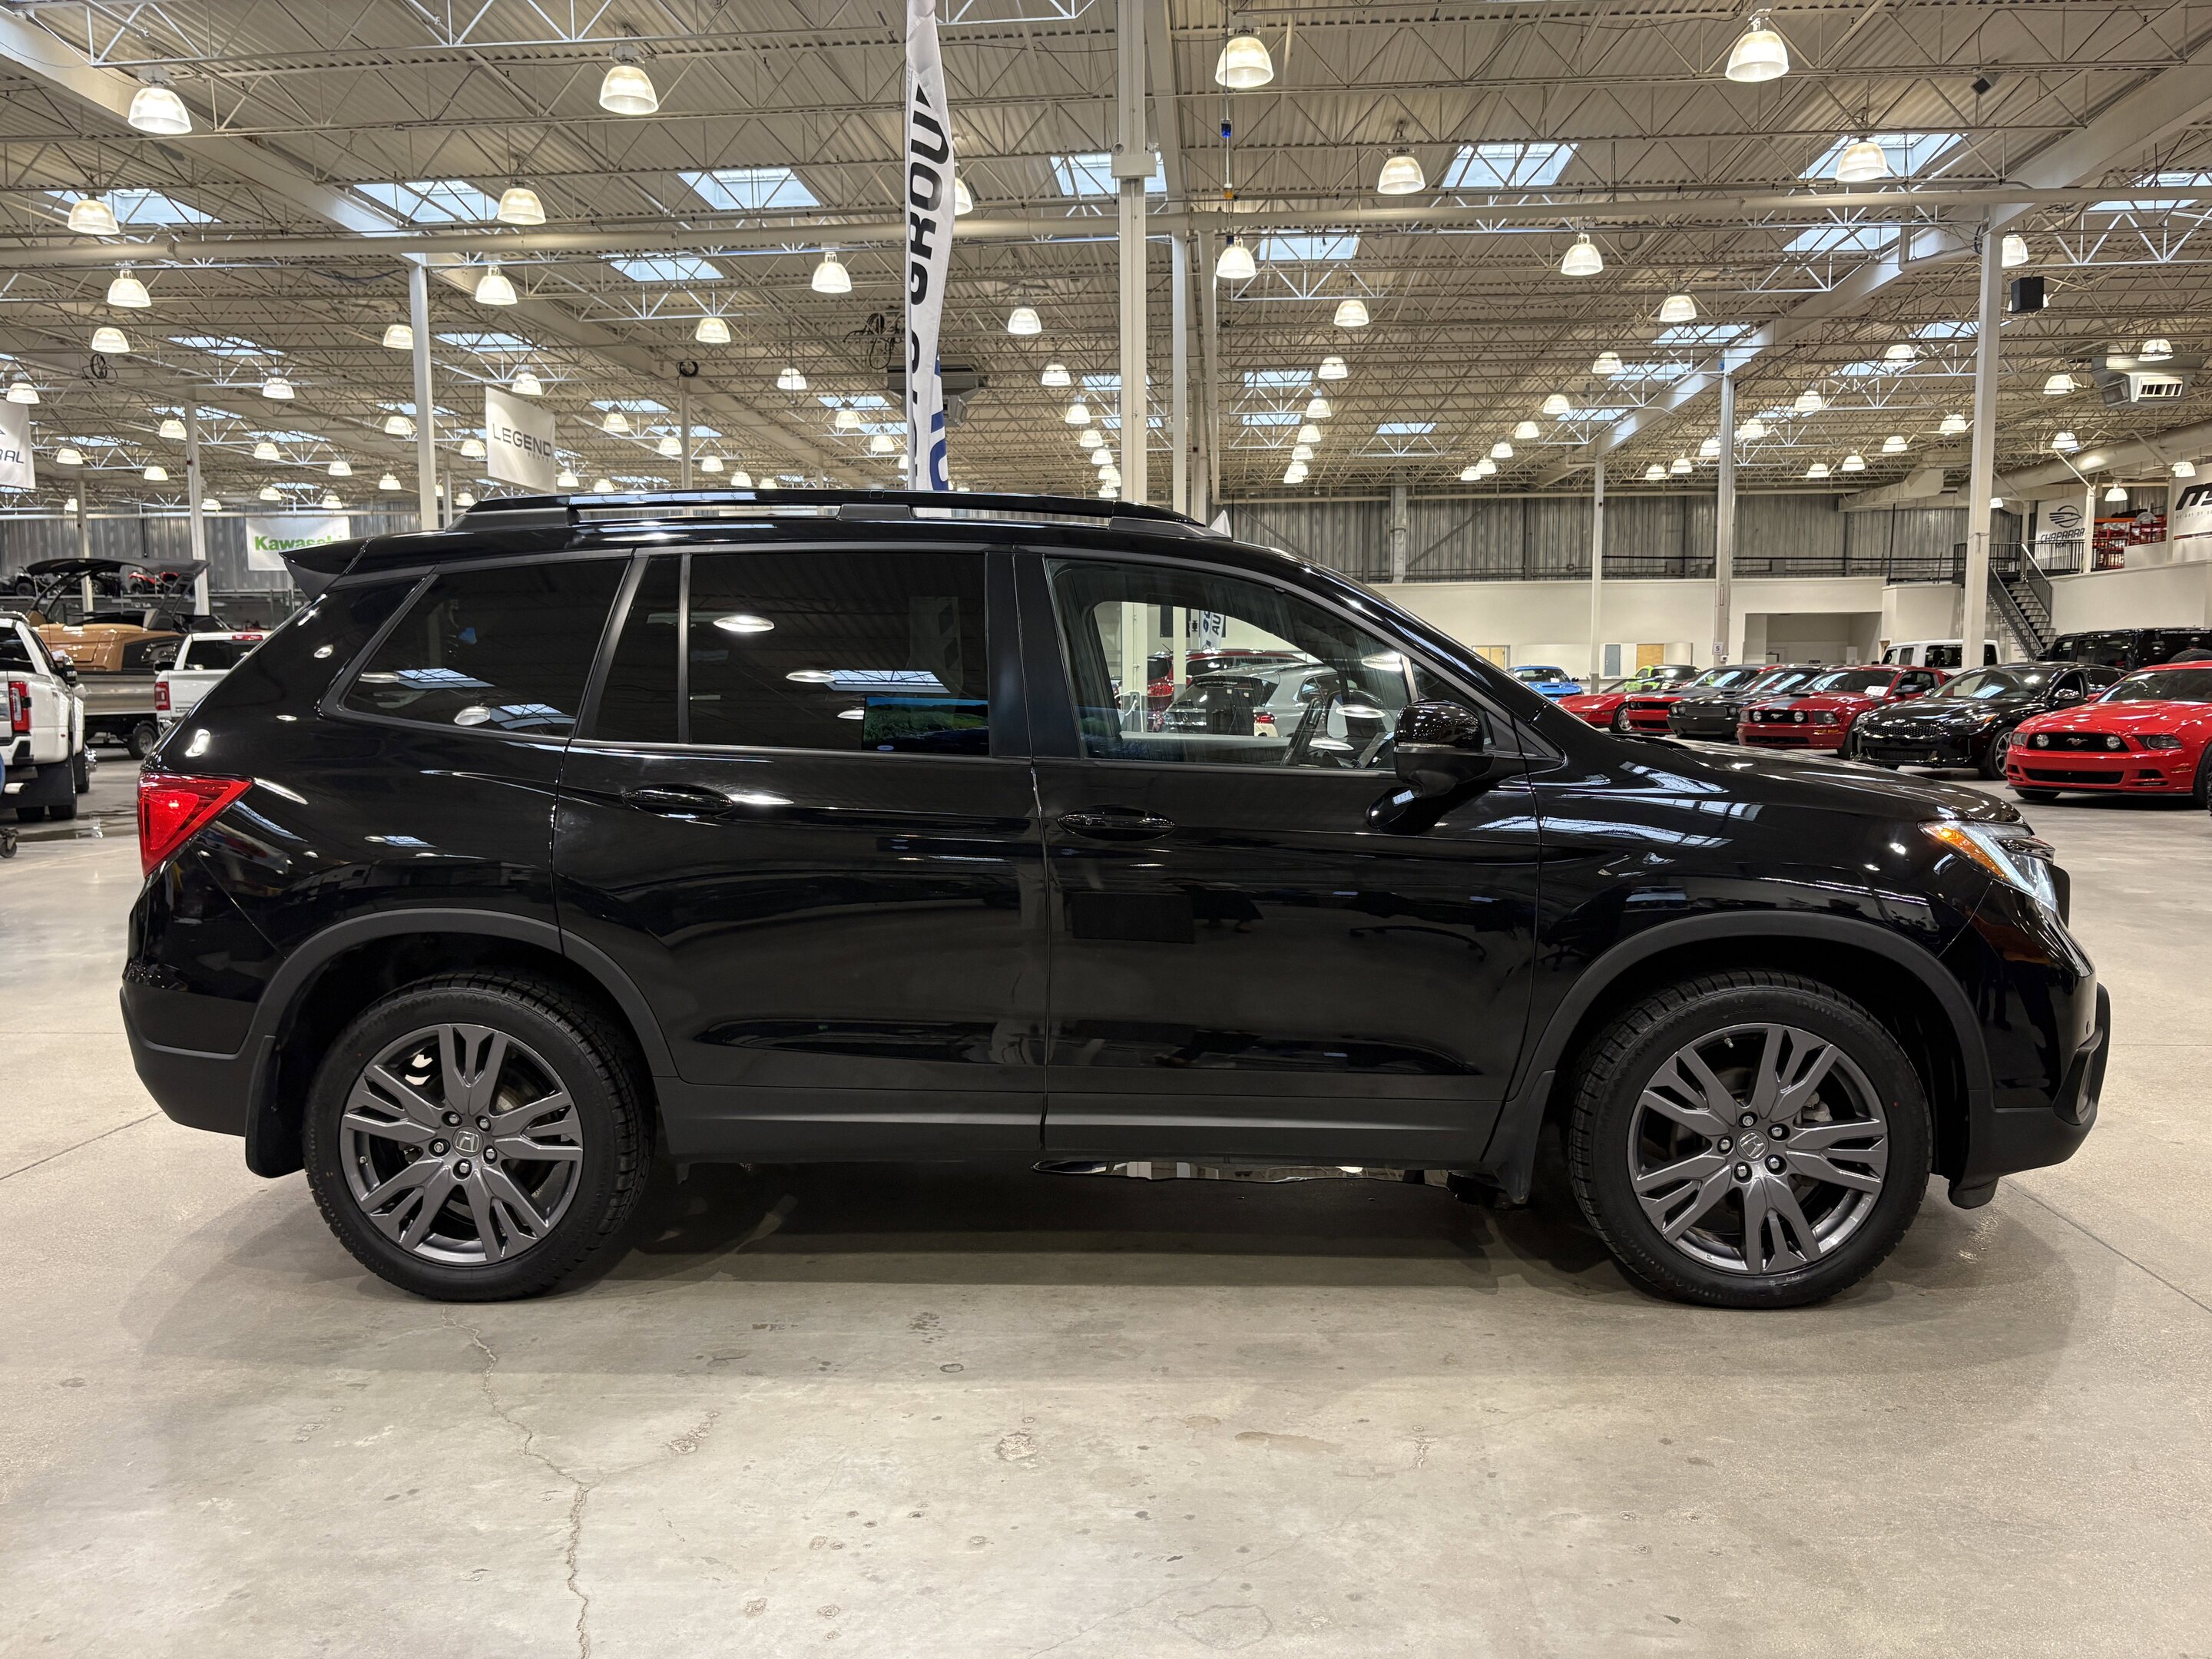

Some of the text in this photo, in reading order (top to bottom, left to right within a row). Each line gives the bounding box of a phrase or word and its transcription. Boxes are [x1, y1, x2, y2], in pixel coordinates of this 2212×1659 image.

[909, 82, 949, 306] GROU
[492, 423, 552, 457] LEGEND
[254, 535, 332, 551] Kawas
